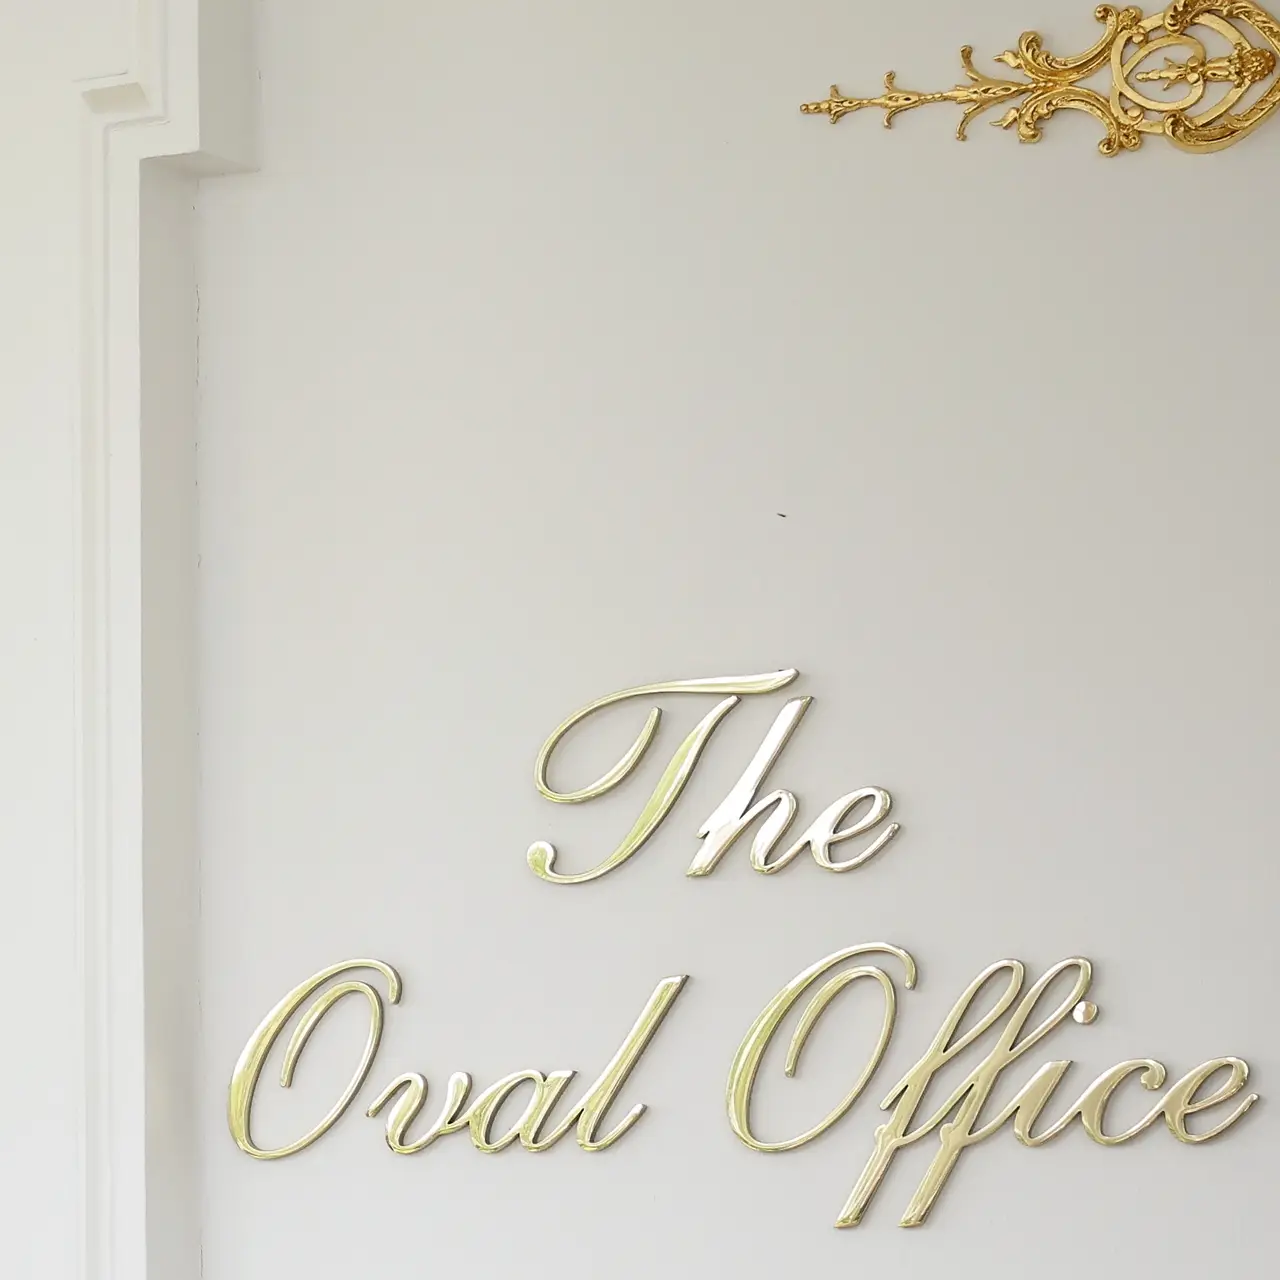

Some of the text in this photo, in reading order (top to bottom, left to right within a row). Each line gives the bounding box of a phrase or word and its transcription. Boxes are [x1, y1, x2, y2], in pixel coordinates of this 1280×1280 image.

[526, 666, 900, 886] The
[228, 941, 1260, 1229] Oval Office
